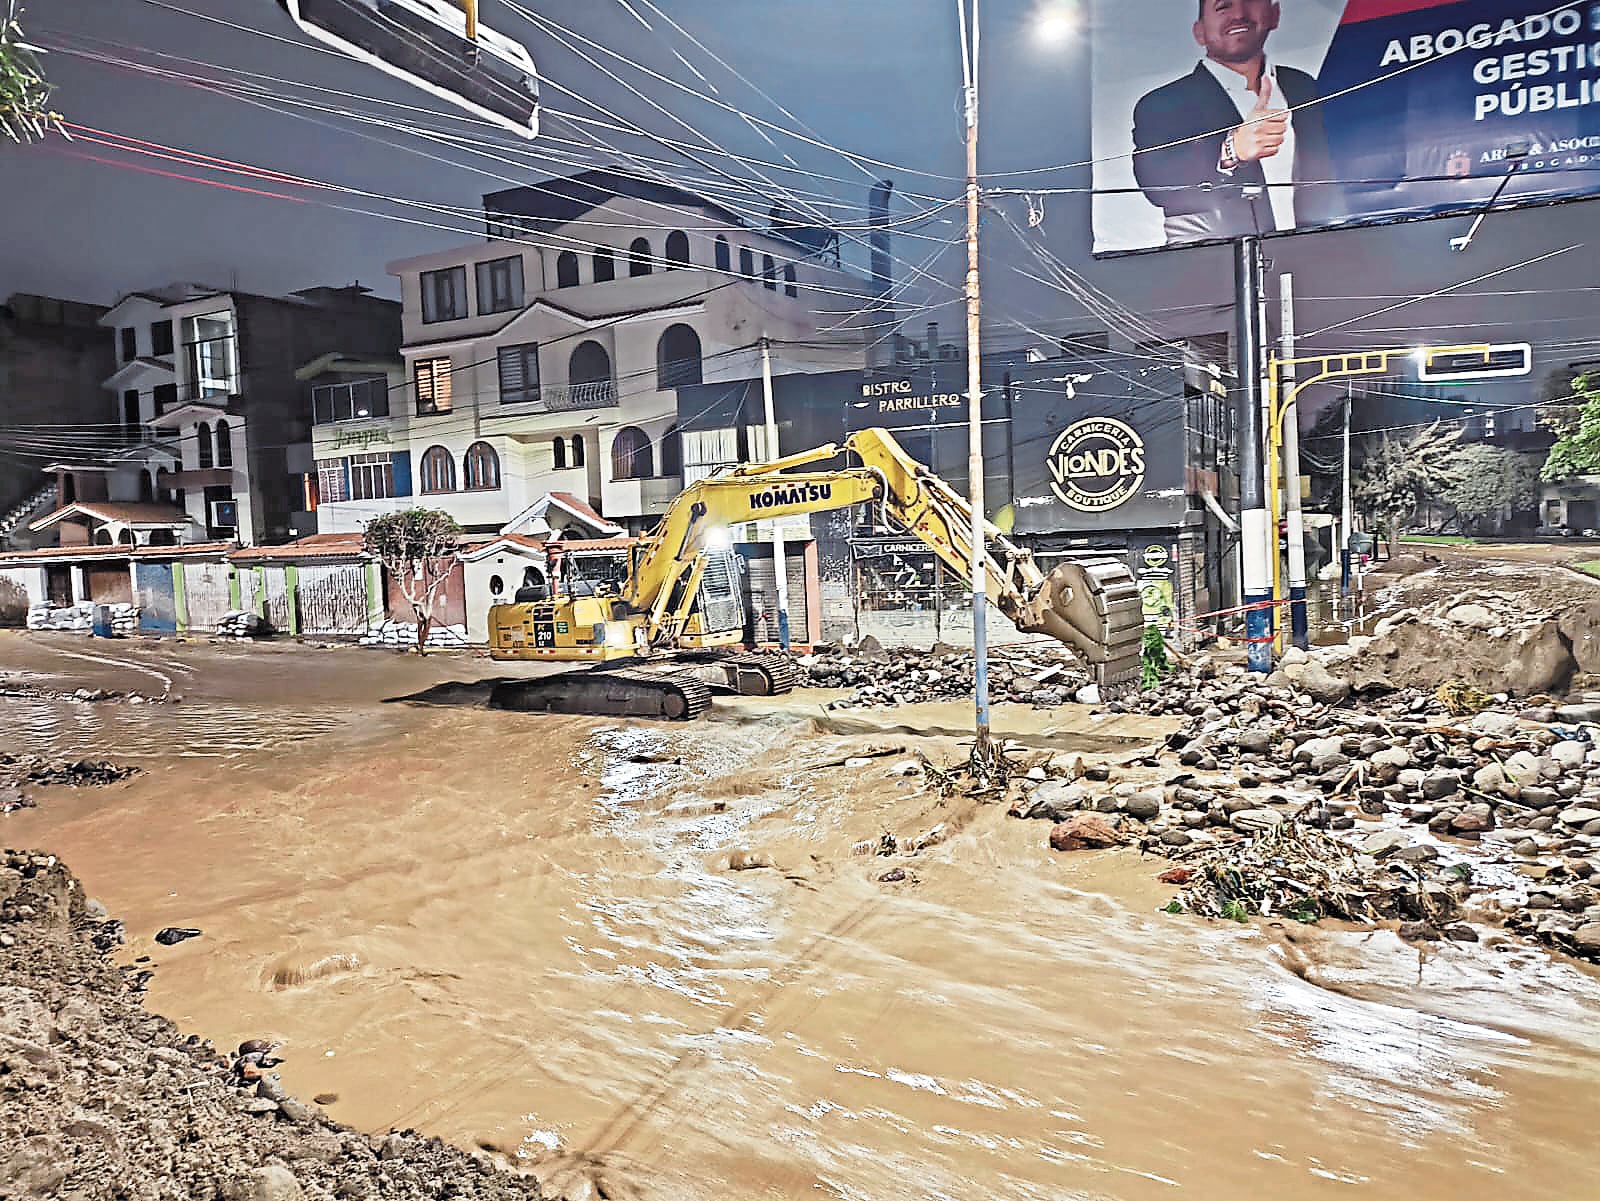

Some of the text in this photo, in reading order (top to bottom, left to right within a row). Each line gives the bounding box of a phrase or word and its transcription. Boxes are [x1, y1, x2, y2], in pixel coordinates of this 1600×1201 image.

[1379, 9, 1582, 68] ABOGADO
[862, 380, 912, 396] BISTRO
[879, 393, 961, 413] PARRILLERO
[1060, 423, 1131, 450] CARNICERIA
[1046, 447, 1145, 484] VIONDES
[750, 482, 832, 509] KOMATSU
[1065, 486, 1128, 506] BOUTIQUE
[537, 631, 552, 641] 210
